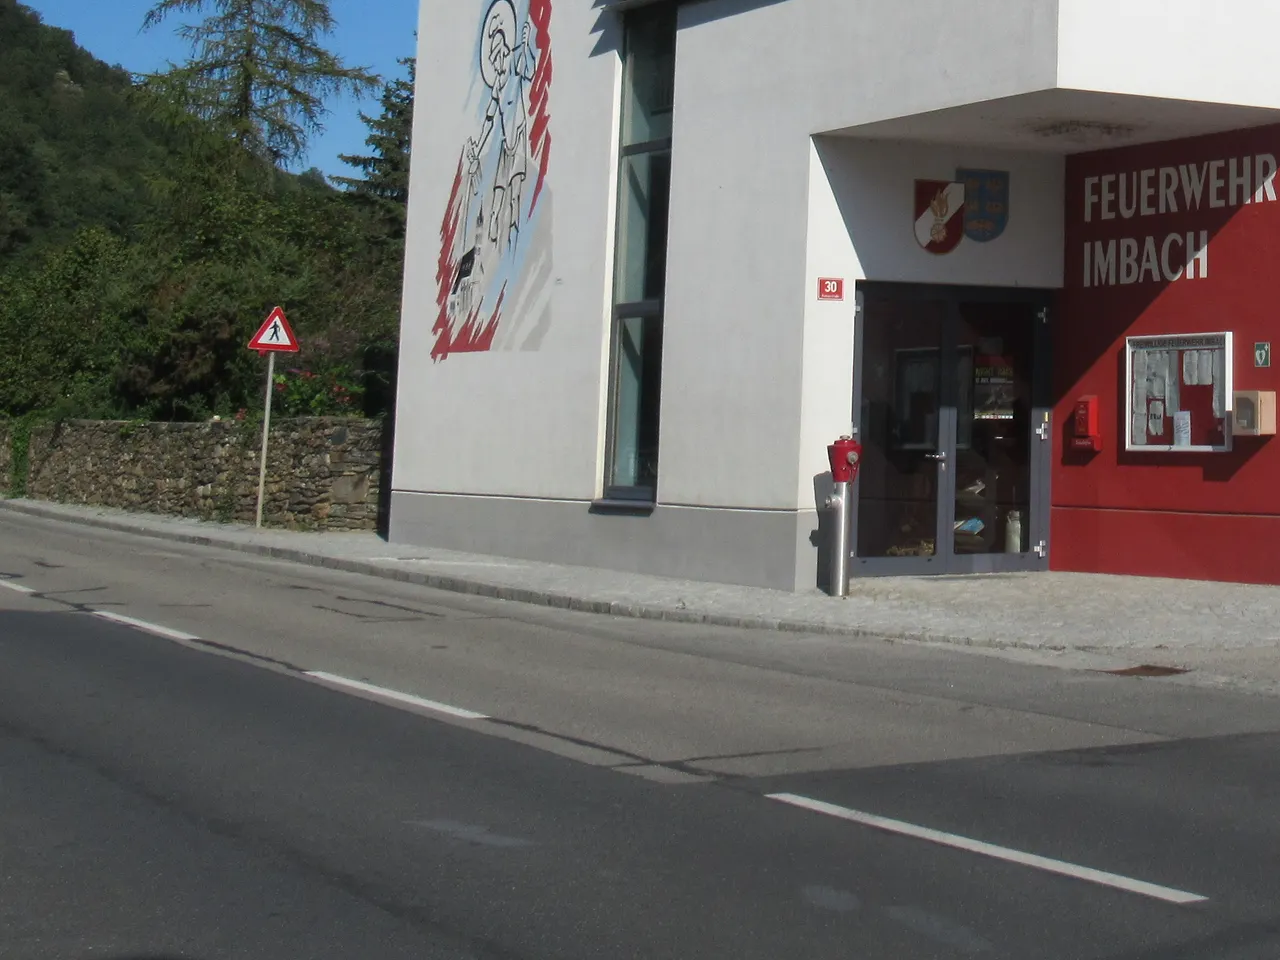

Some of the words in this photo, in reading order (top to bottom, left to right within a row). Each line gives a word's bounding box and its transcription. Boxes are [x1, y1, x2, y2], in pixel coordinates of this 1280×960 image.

[1084, 153, 1277, 222] FEUERWEHR
[824, 280, 838, 293] 30
[1083, 230, 1208, 287] IMBACH
